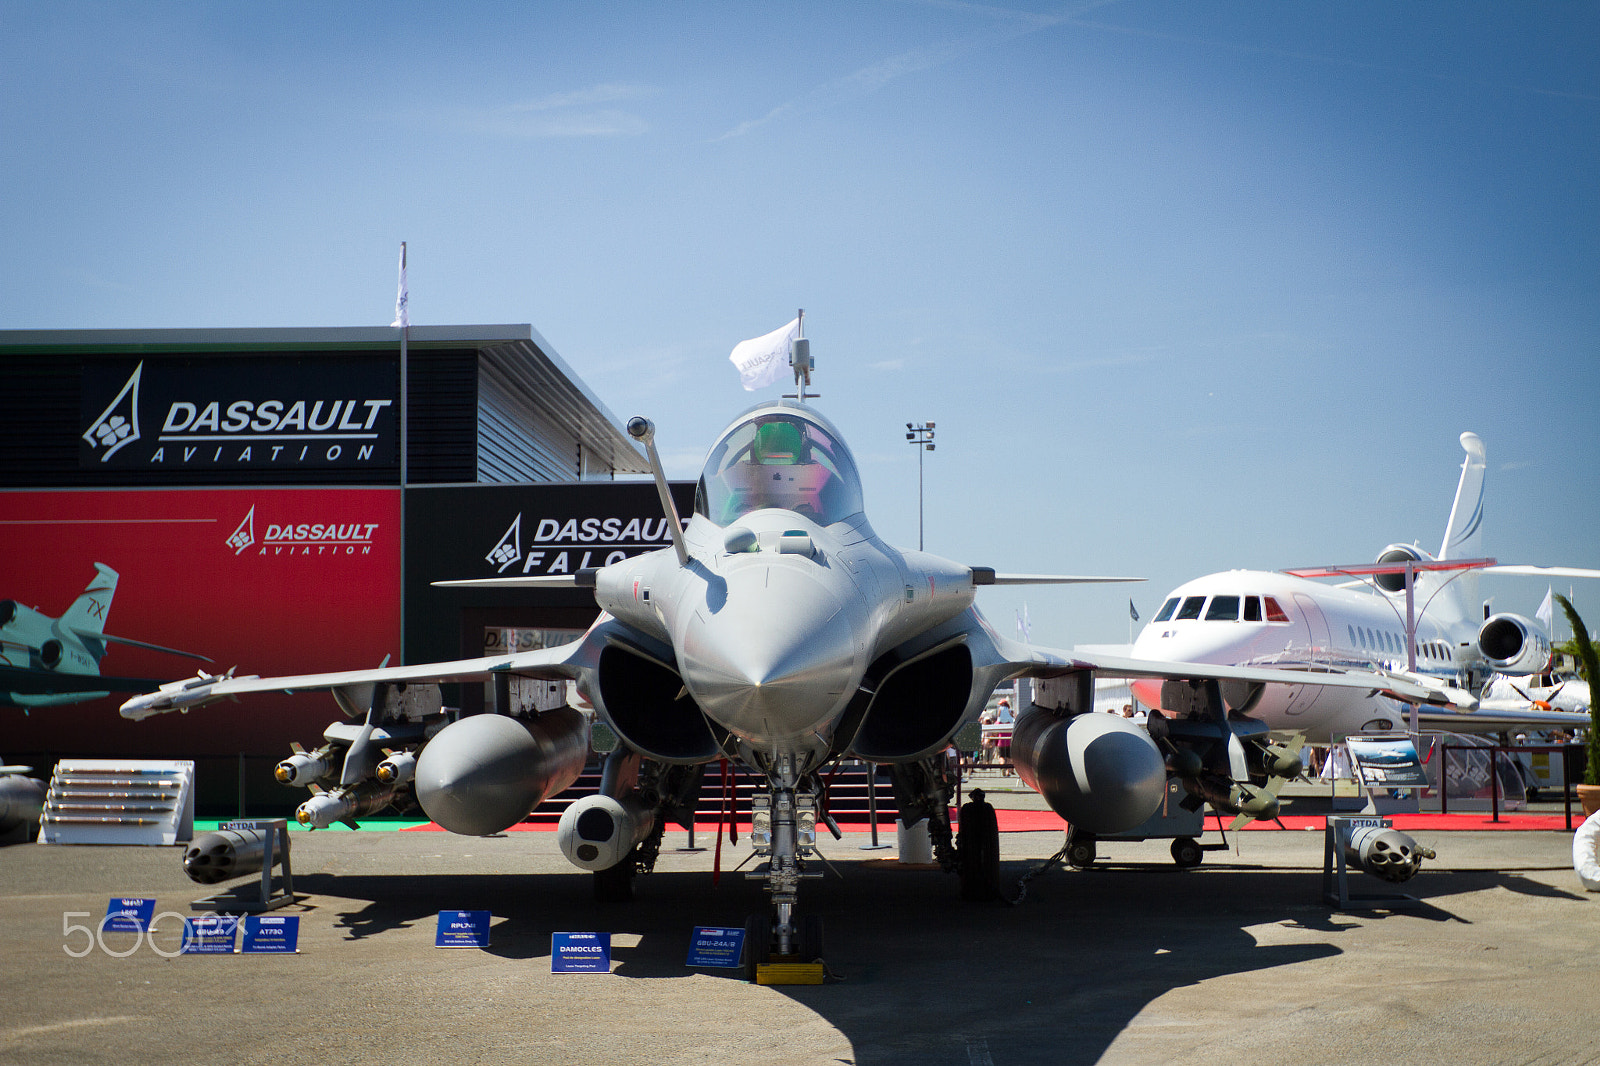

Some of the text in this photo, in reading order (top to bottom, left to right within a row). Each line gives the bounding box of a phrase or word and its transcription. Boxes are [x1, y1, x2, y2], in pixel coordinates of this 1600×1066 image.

[162, 400, 392, 432] DASSAULT
[150, 445, 374, 462] AVIATION
[264, 524, 379, 540] DASSAULT
[259, 546, 371, 555] AVIATION
[522, 550, 652, 573] FALC
[87, 597, 106, 620] 7X
